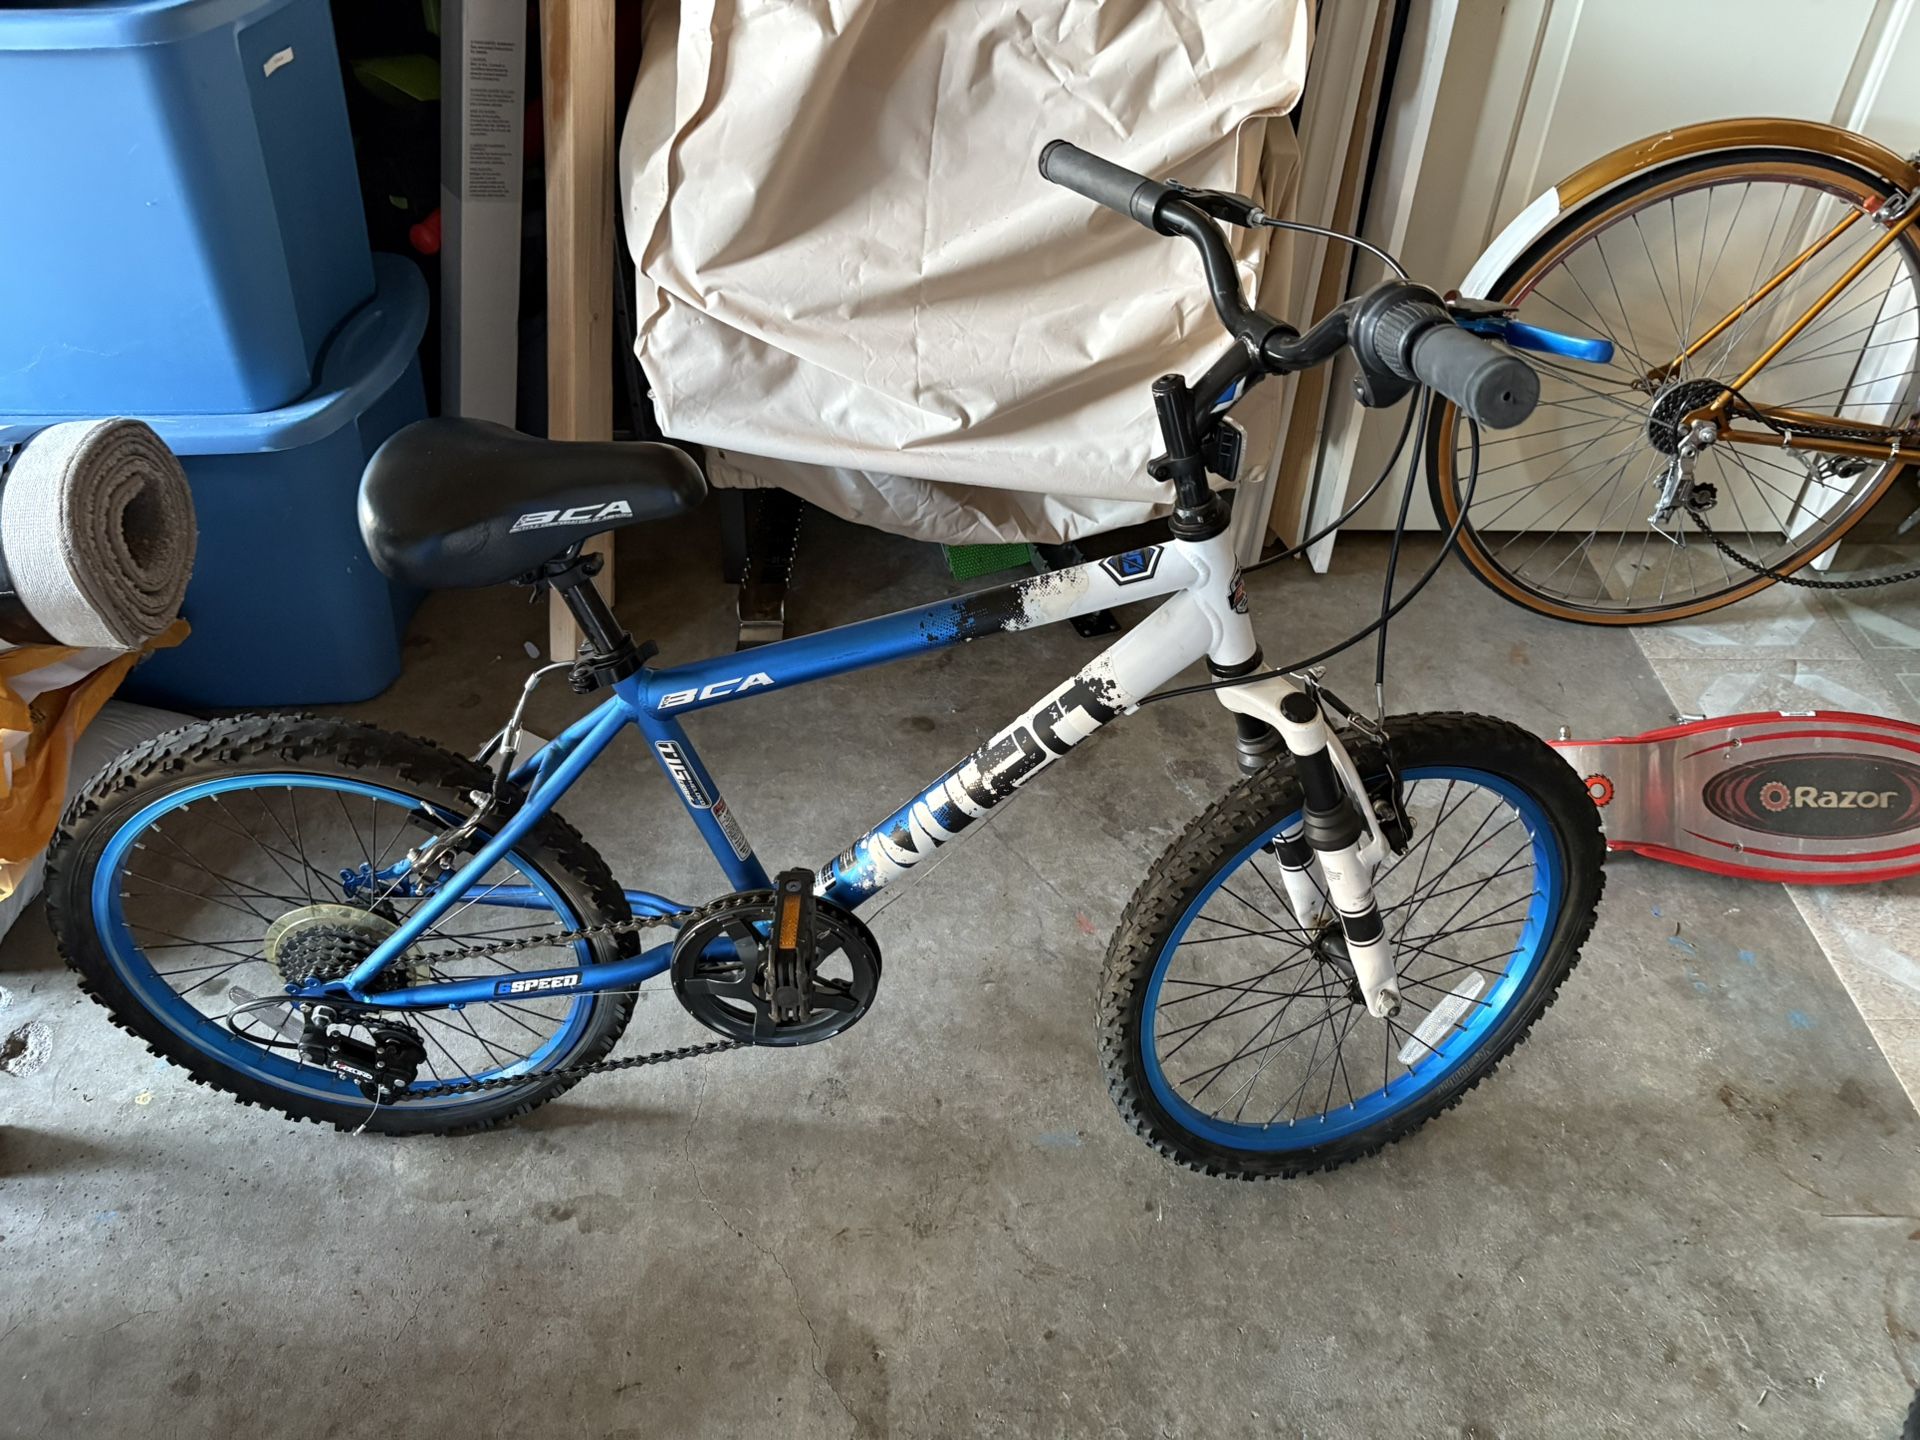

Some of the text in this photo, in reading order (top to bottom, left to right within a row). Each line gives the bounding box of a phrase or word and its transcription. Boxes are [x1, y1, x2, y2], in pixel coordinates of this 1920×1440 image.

[512, 500, 632, 529] BCA
[657, 671, 775, 710] BCA
[658, 742, 692, 782] TIG
[1794, 786, 1899, 809] Razor
